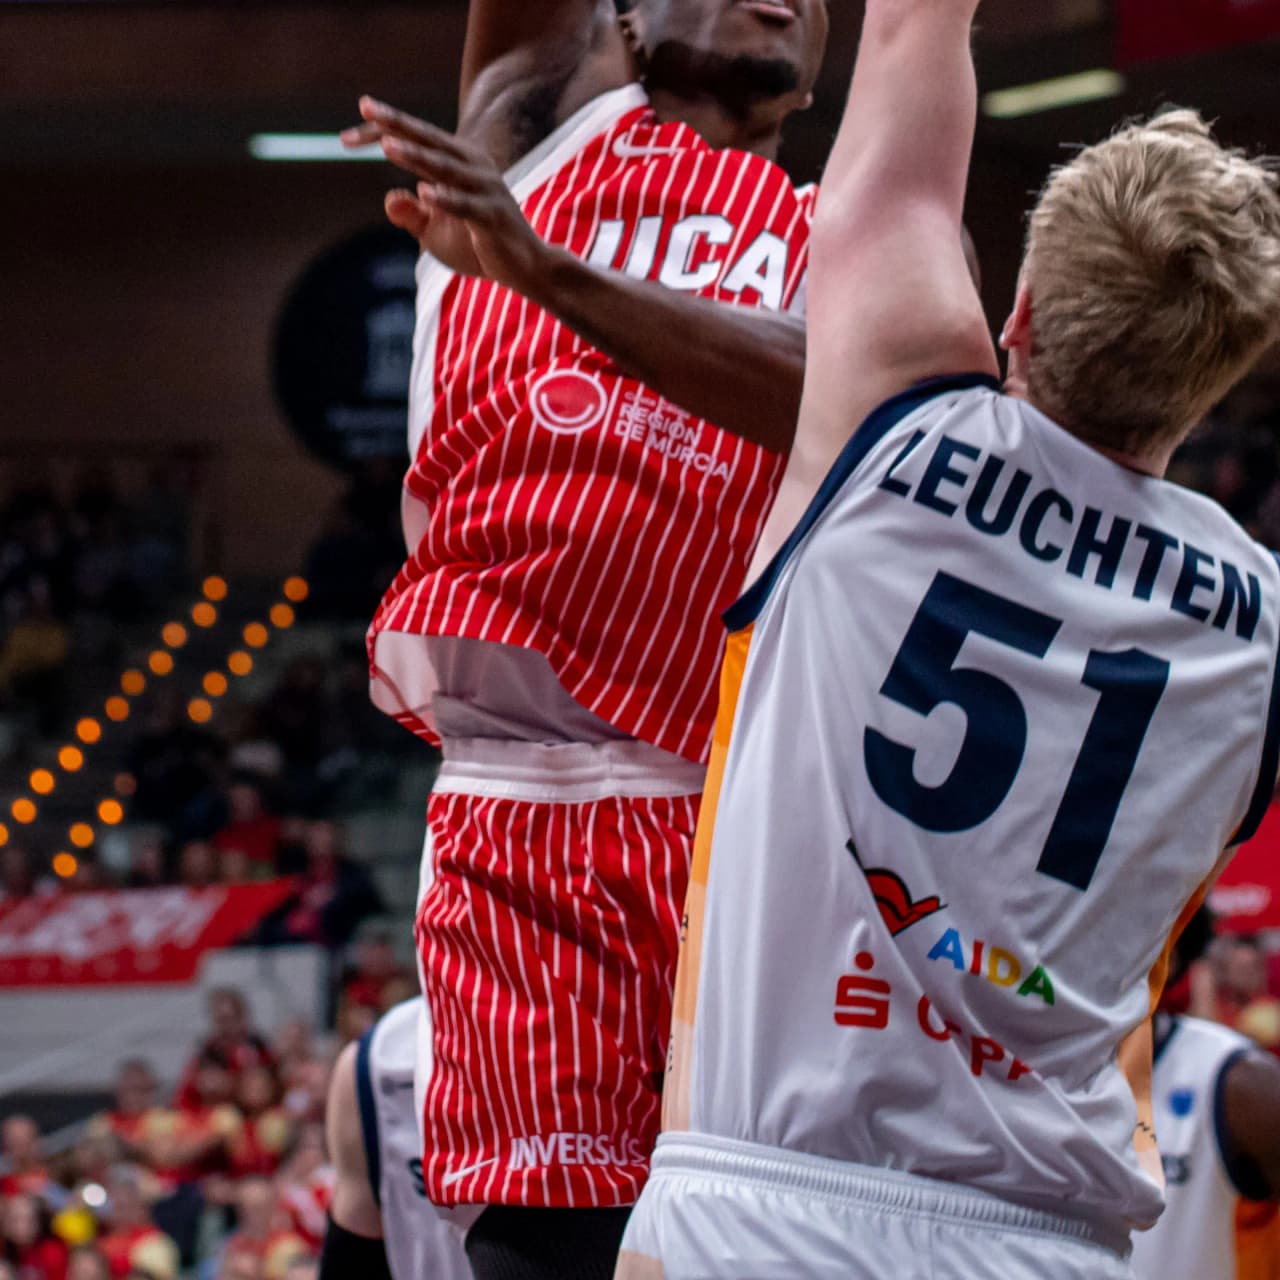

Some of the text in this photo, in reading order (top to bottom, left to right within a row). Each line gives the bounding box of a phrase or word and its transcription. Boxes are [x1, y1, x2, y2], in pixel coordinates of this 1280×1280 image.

[585, 215, 806, 311] UCA
[613, 420, 730, 480] DE MURCIA
[878, 428, 1262, 642] LEUCHTEN
[863, 570, 1171, 892] 51
[927, 927, 1056, 1007] AIDA
[507, 1131, 647, 1170] INVERSUS
